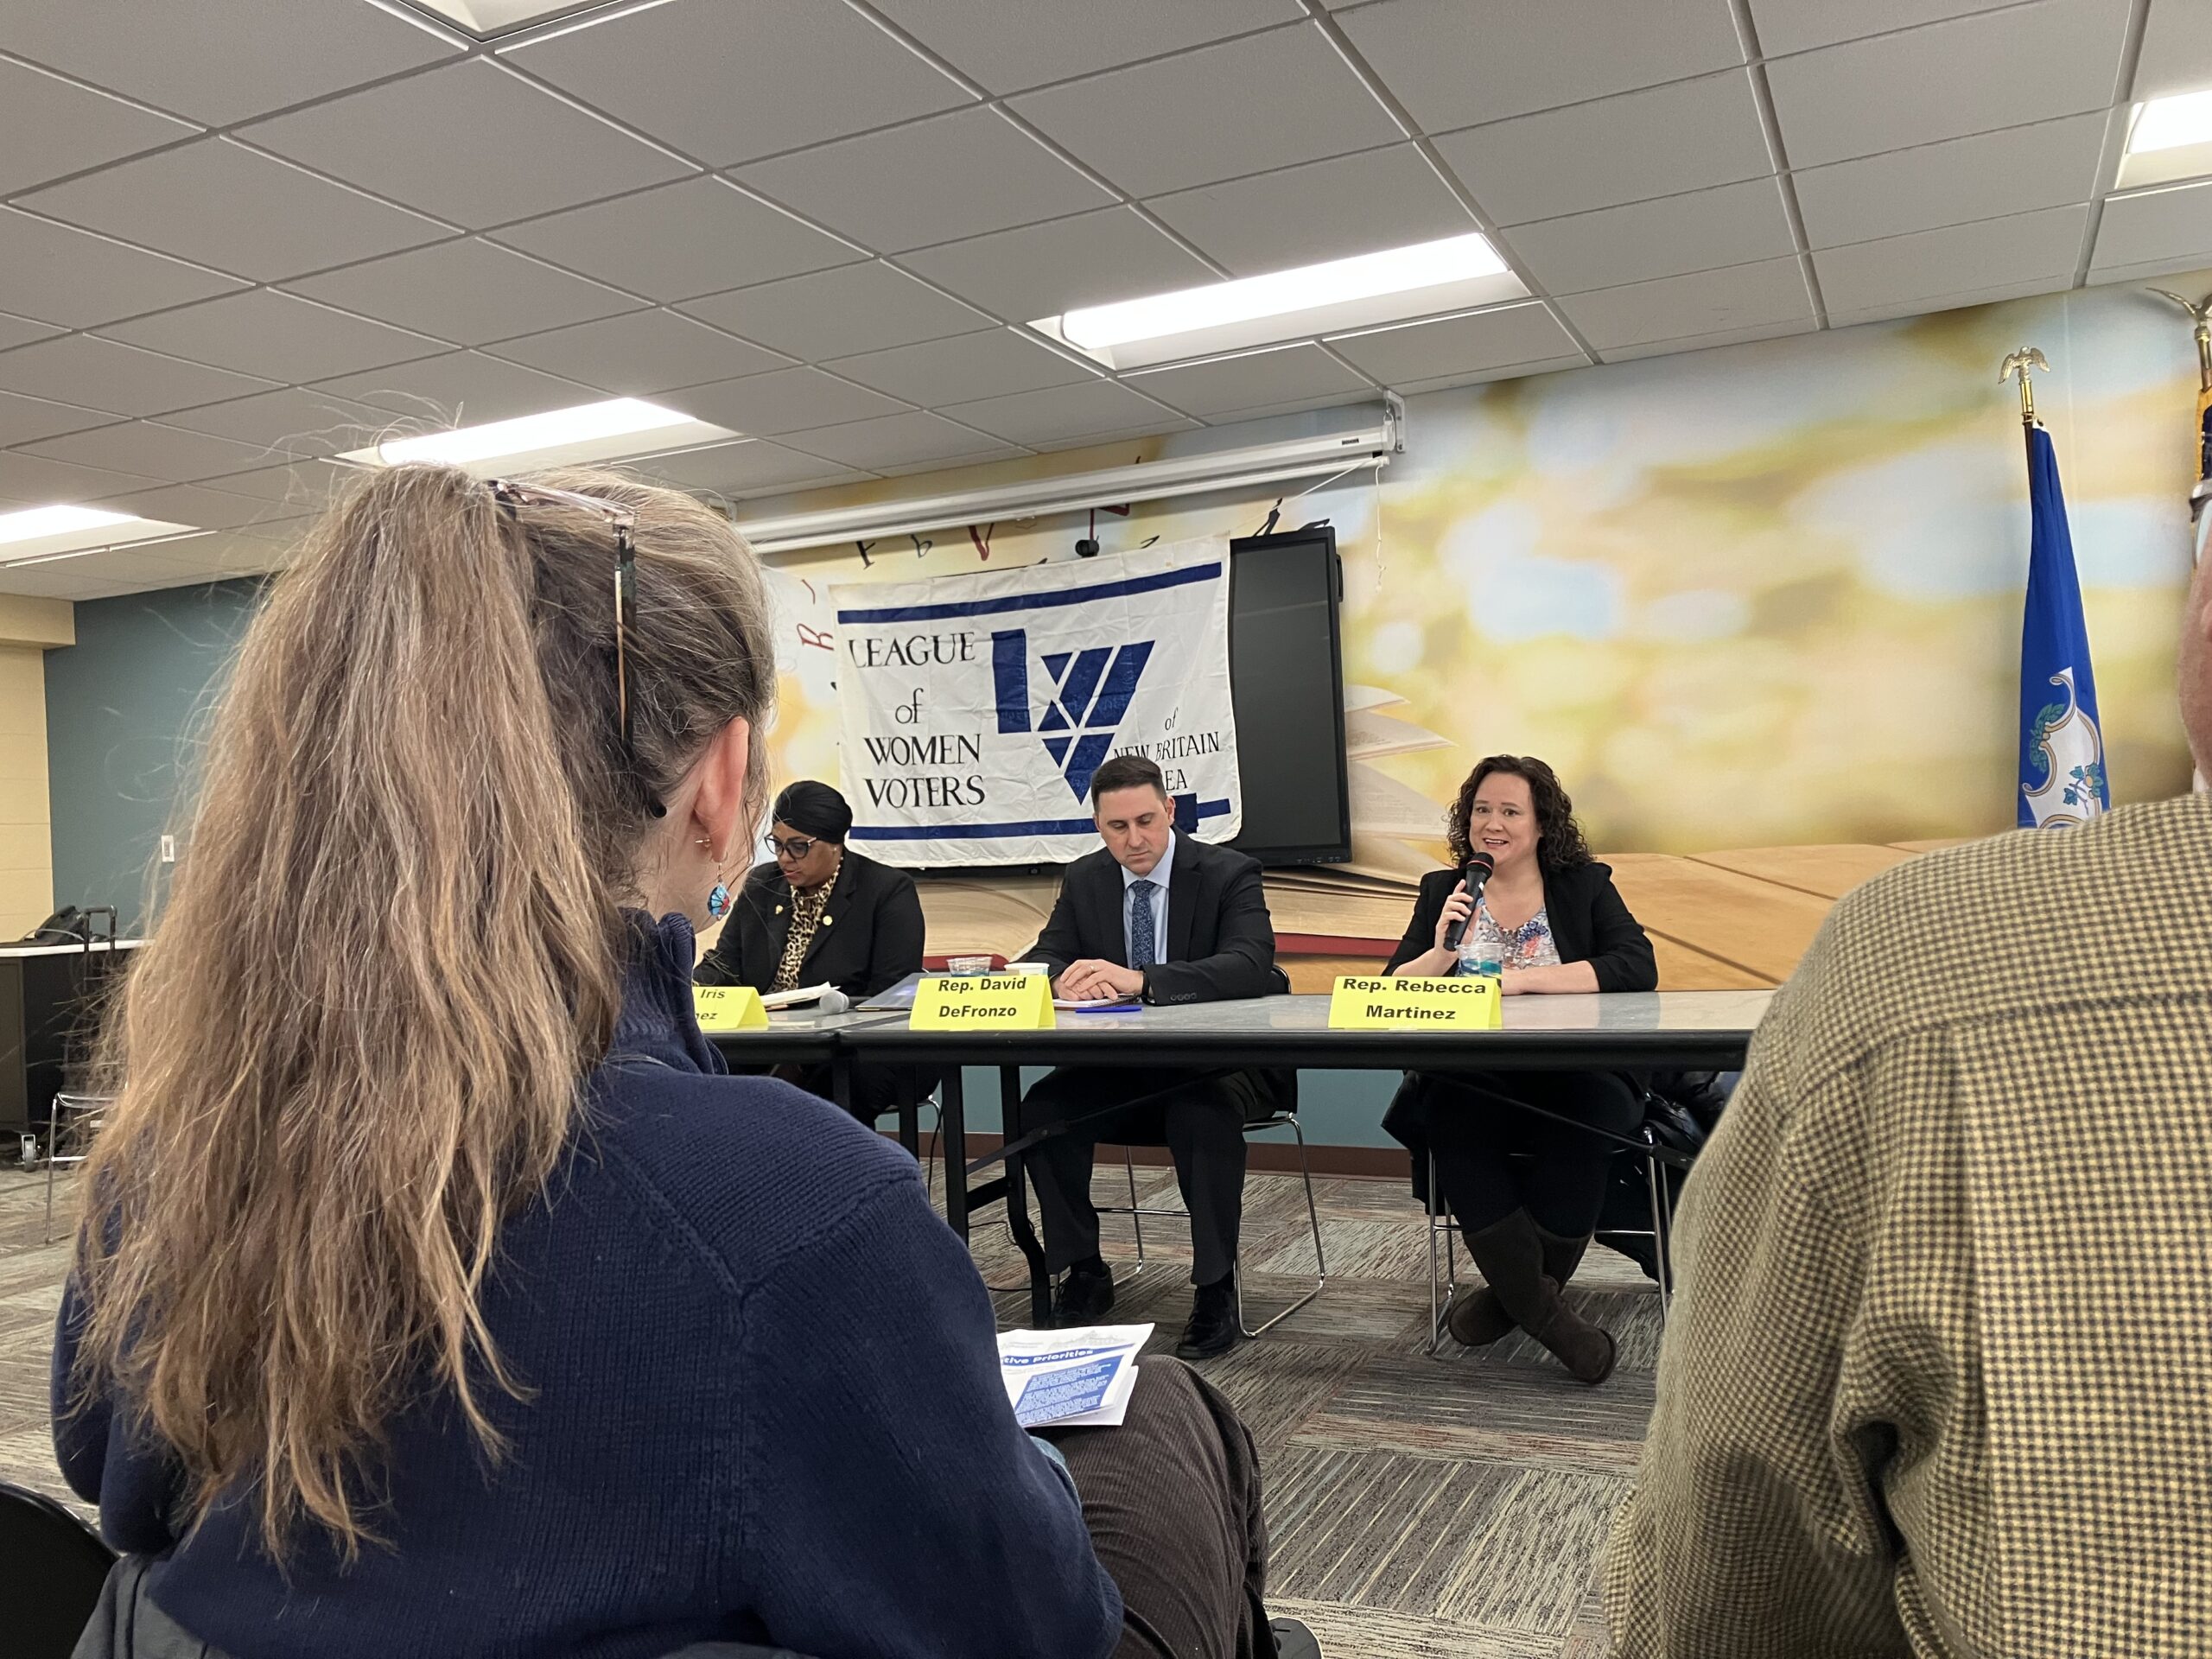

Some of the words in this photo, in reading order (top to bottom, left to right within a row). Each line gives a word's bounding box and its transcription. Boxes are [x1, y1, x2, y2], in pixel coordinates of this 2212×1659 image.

[849, 632, 976, 668] LEAGUE
[895, 688, 924, 724] of
[1165, 707, 1179, 731] of
[863, 734, 982, 766] WOMEN
[1154, 731, 1220, 762] BRITAIN
[863, 775, 986, 809] VOTERS
[701, 988, 726, 999] Iris
[938, 979, 974, 994] Rep.
[980, 977, 1027, 990] David
[1343, 978, 1387, 993] Rep.
[1395, 979, 1486, 994] Rebecca
[938, 1005, 1017, 1018] DeFronzo
[1366, 1005, 1456, 1020] Martinez
[1033, 1349, 1094, 1363] Priorities
